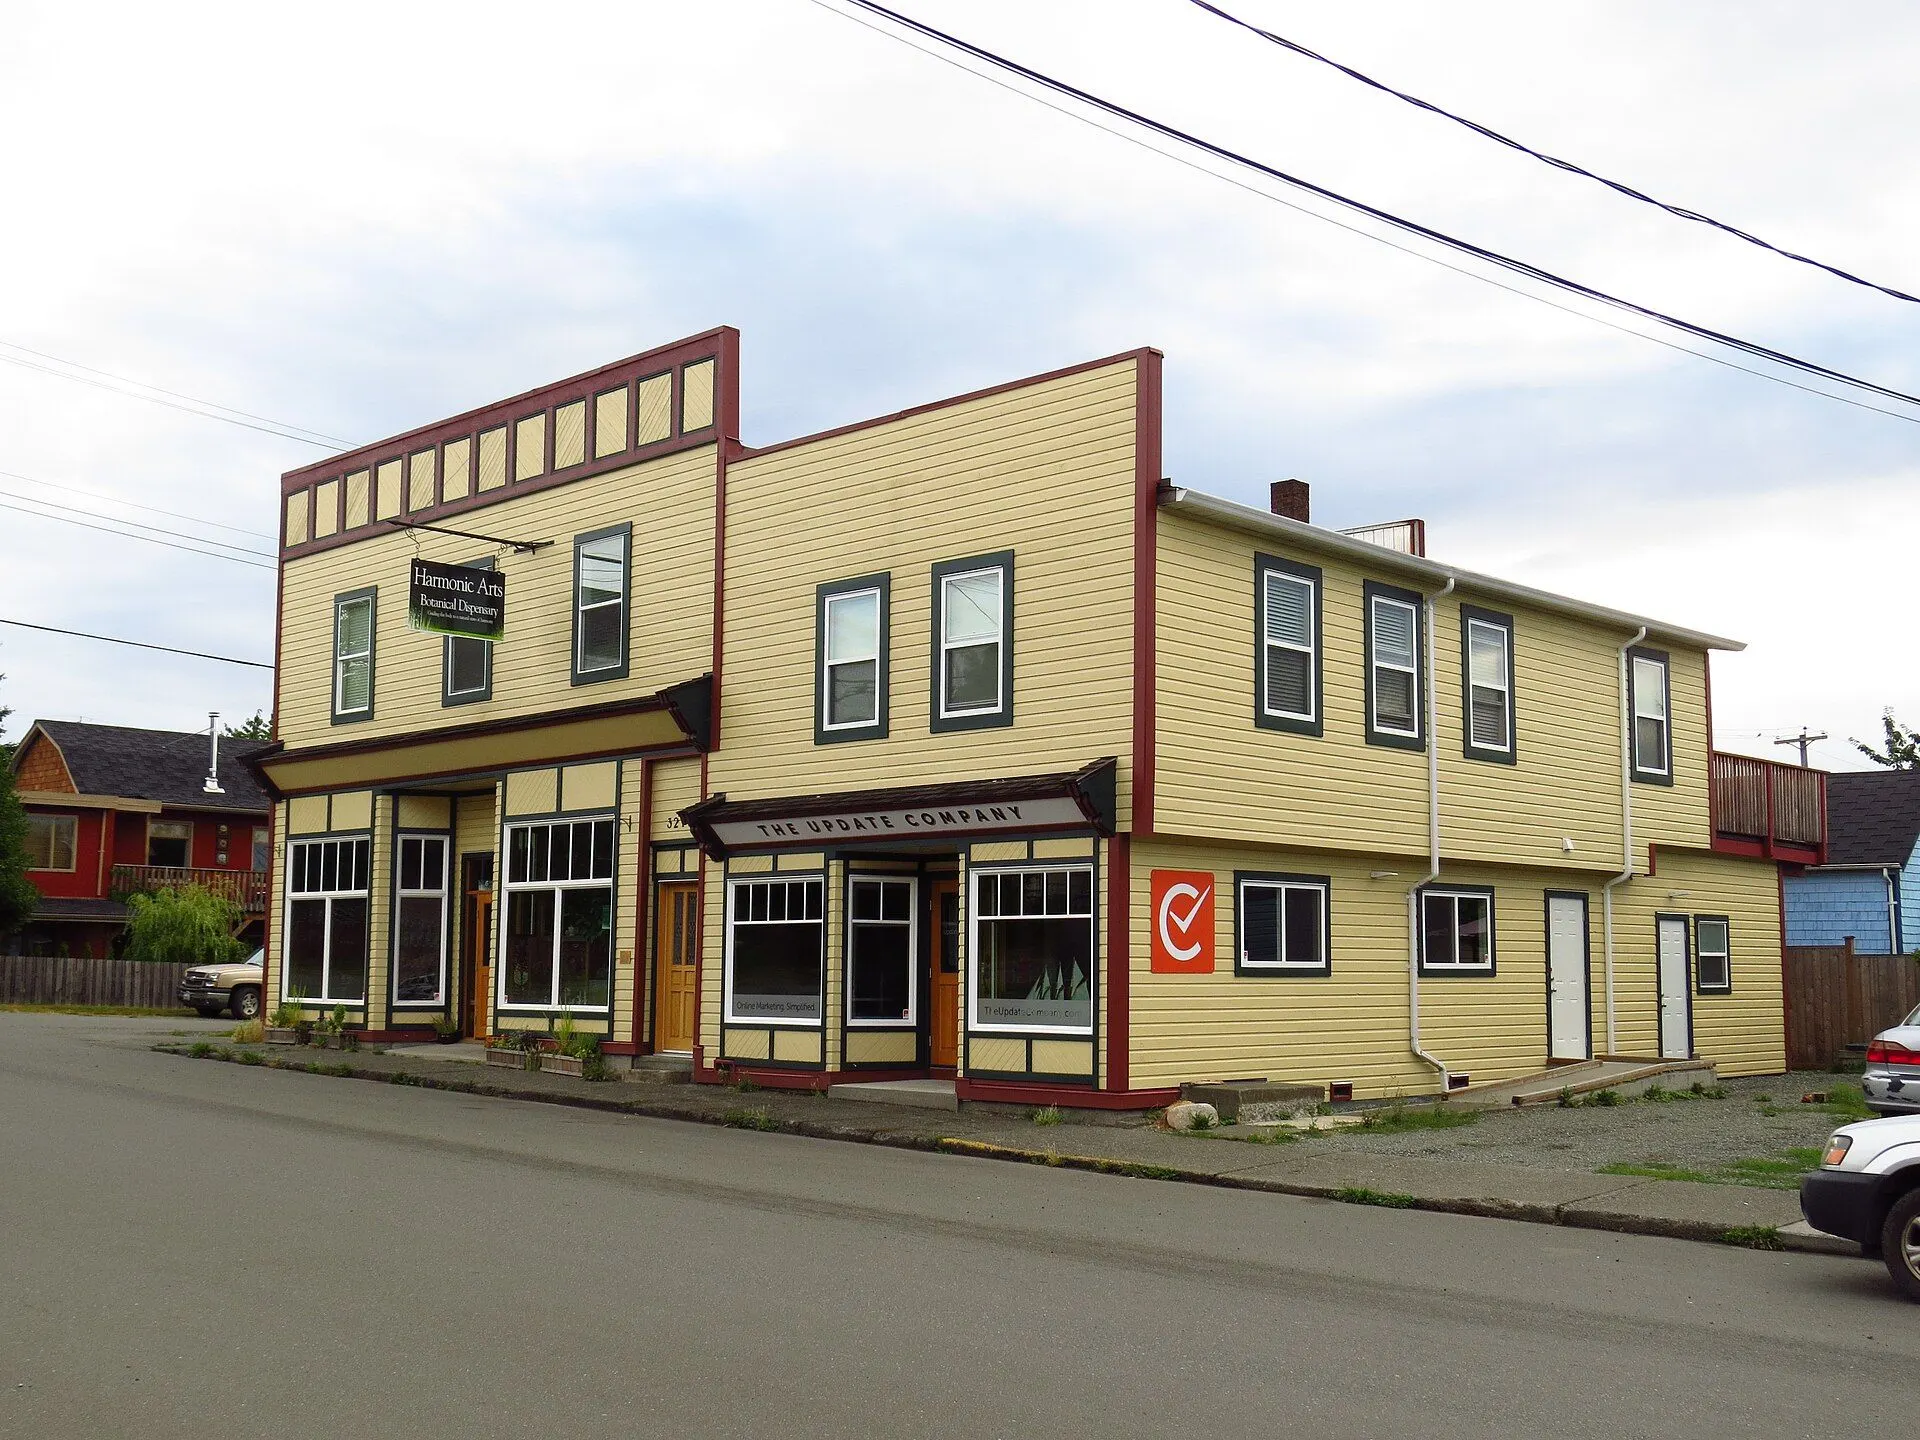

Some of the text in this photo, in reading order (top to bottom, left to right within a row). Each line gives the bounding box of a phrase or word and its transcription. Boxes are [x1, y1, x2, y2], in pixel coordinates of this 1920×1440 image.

[414, 567, 503, 598] Harmonic Arts
[420, 593, 457, 611] Botanical
[458, 599, 499, 619] Dispensary
[667, 817, 684, 829] 32
[757, 806, 1022, 837] THE UPDATE COMPANY
[736, 1001, 756, 1010] Online
